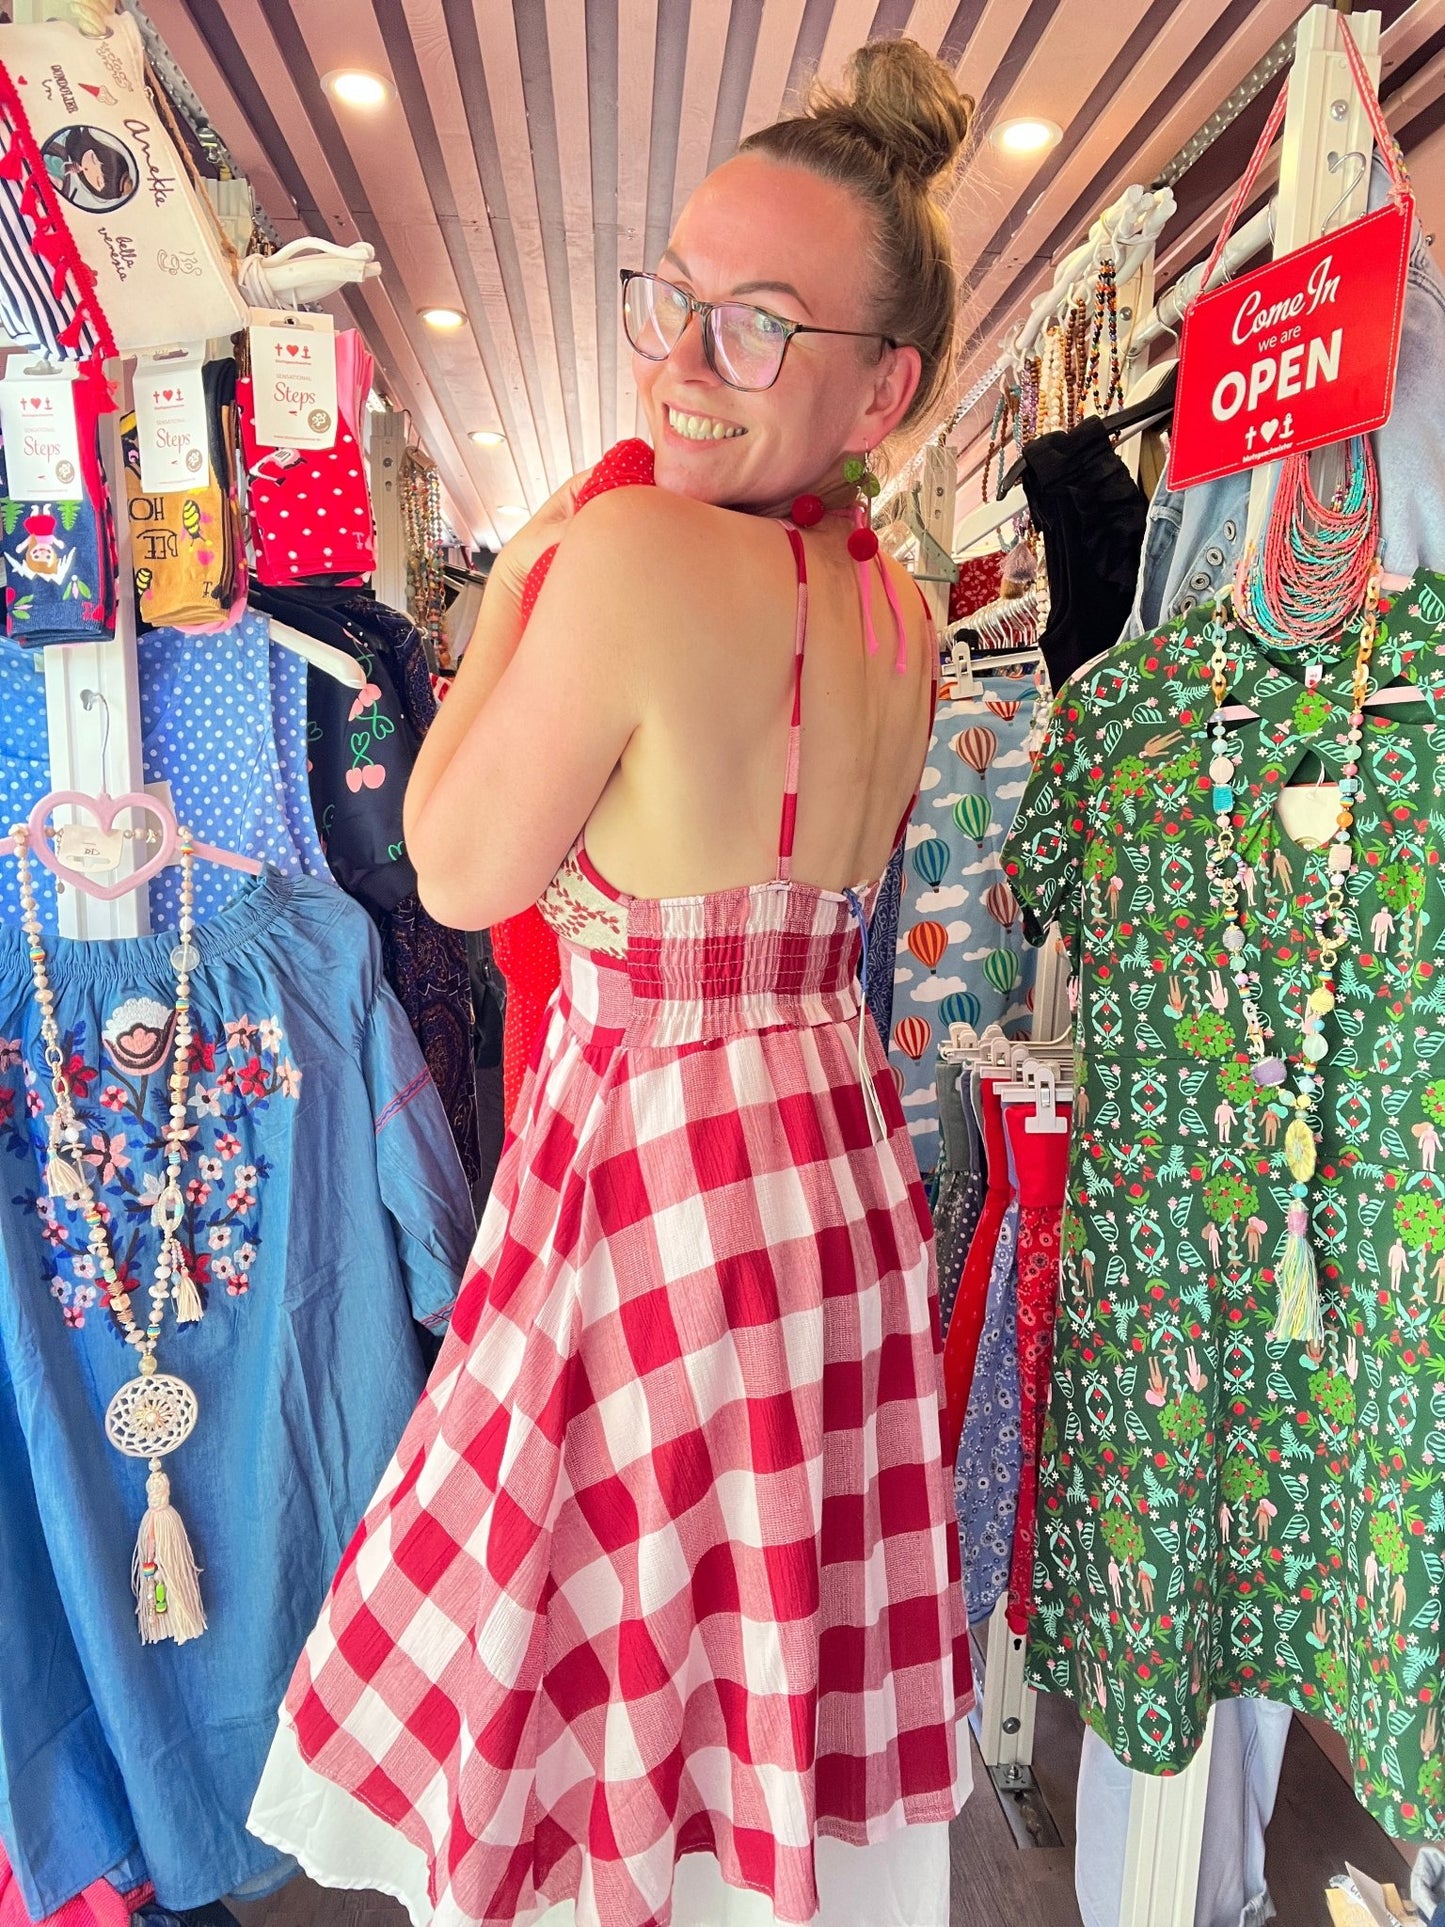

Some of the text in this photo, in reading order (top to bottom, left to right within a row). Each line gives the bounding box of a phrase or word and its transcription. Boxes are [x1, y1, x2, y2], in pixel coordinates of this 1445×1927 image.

[115, 236, 137, 268] bella
[1232, 255, 1341, 346] Come In
[1258, 325, 1302, 352] we are
[1211, 328, 1343, 422] OPEN
[273, 381, 317, 411] Steps
[23, 435, 61, 463] Steps
[155, 427, 191, 454] Steps
[127, 496, 165, 523] HO
[136, 528, 178, 560] BEE
